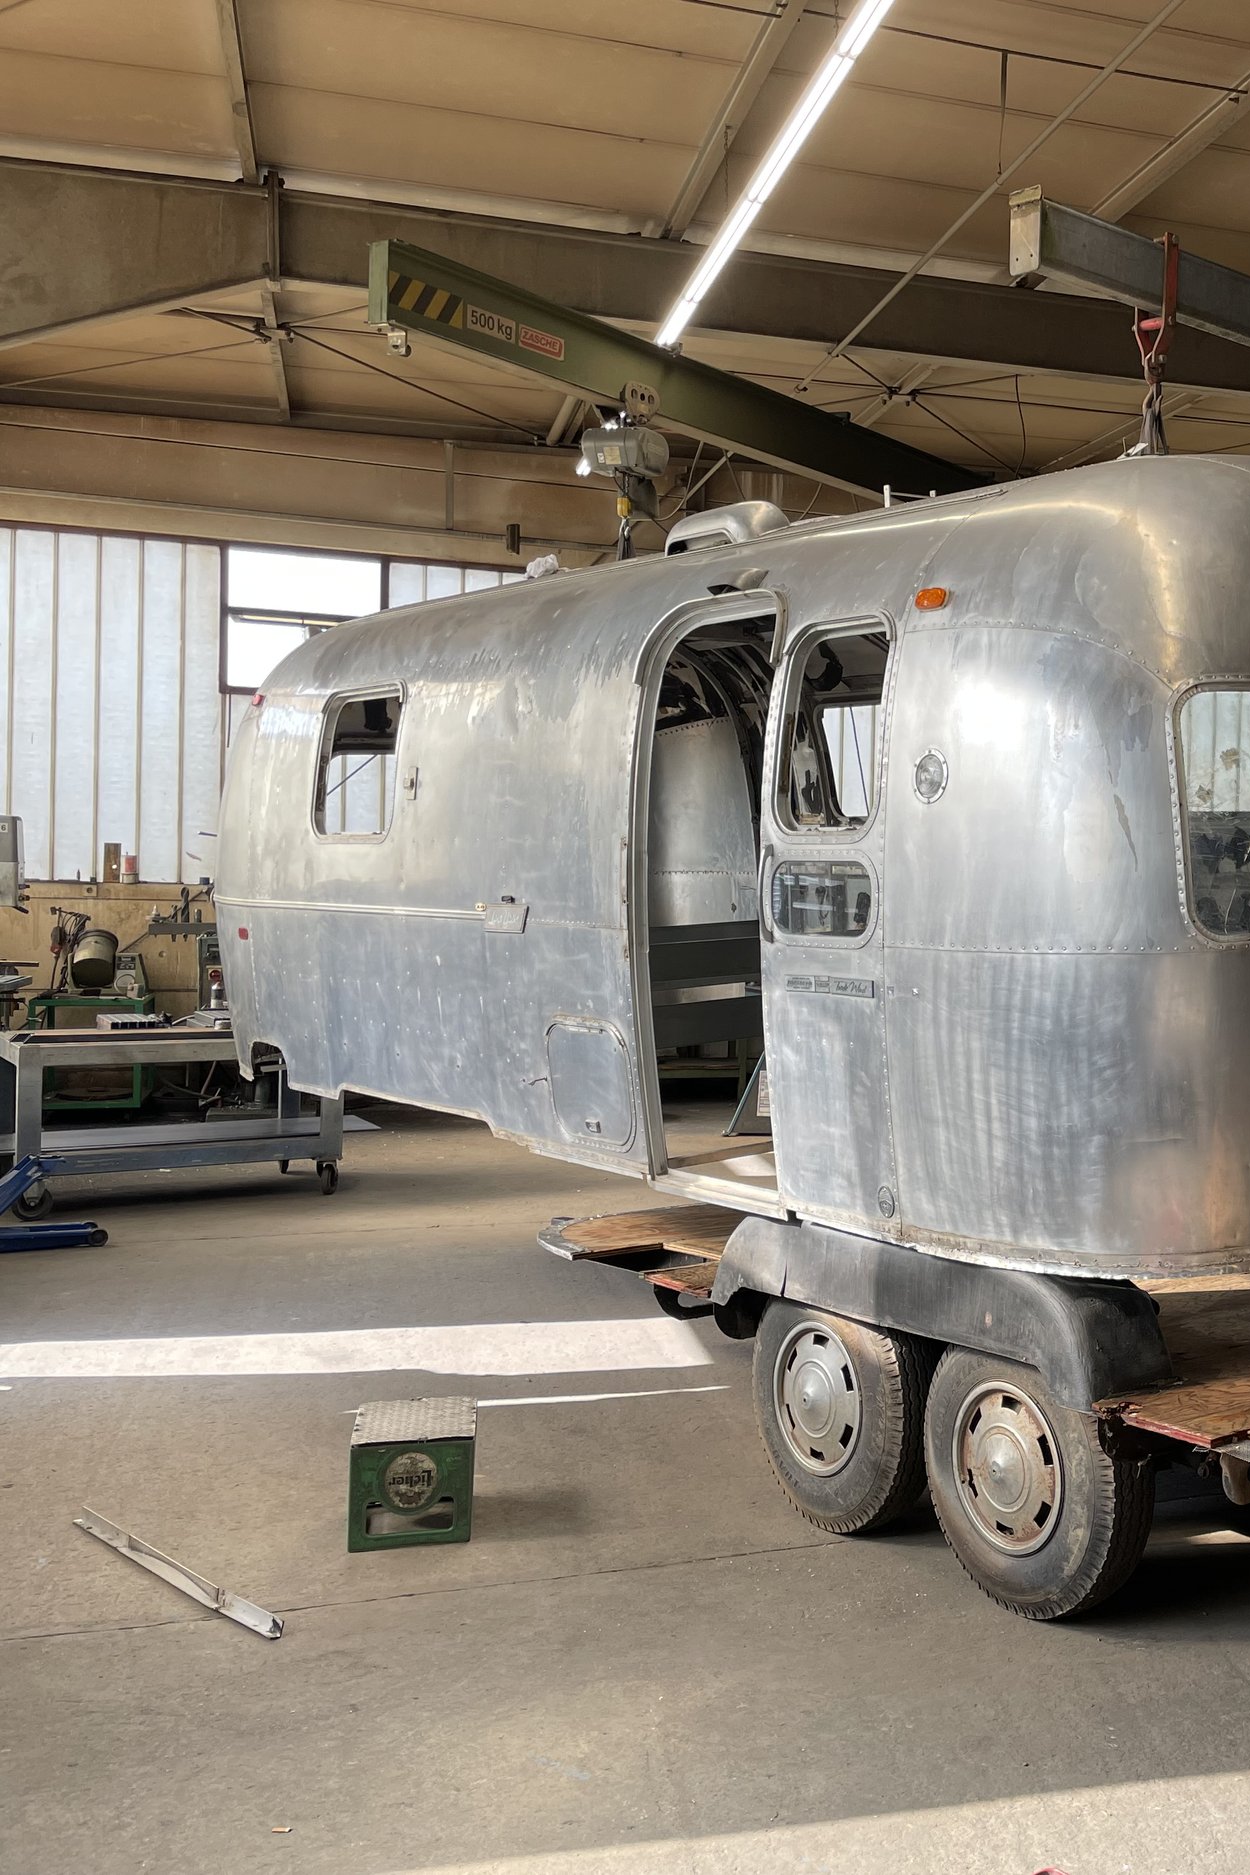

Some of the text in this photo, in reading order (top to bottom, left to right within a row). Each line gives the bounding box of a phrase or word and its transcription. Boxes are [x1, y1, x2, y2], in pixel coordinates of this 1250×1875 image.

[470, 309, 513, 341] 500 kg
[522, 330, 559, 352] ZASCHE
